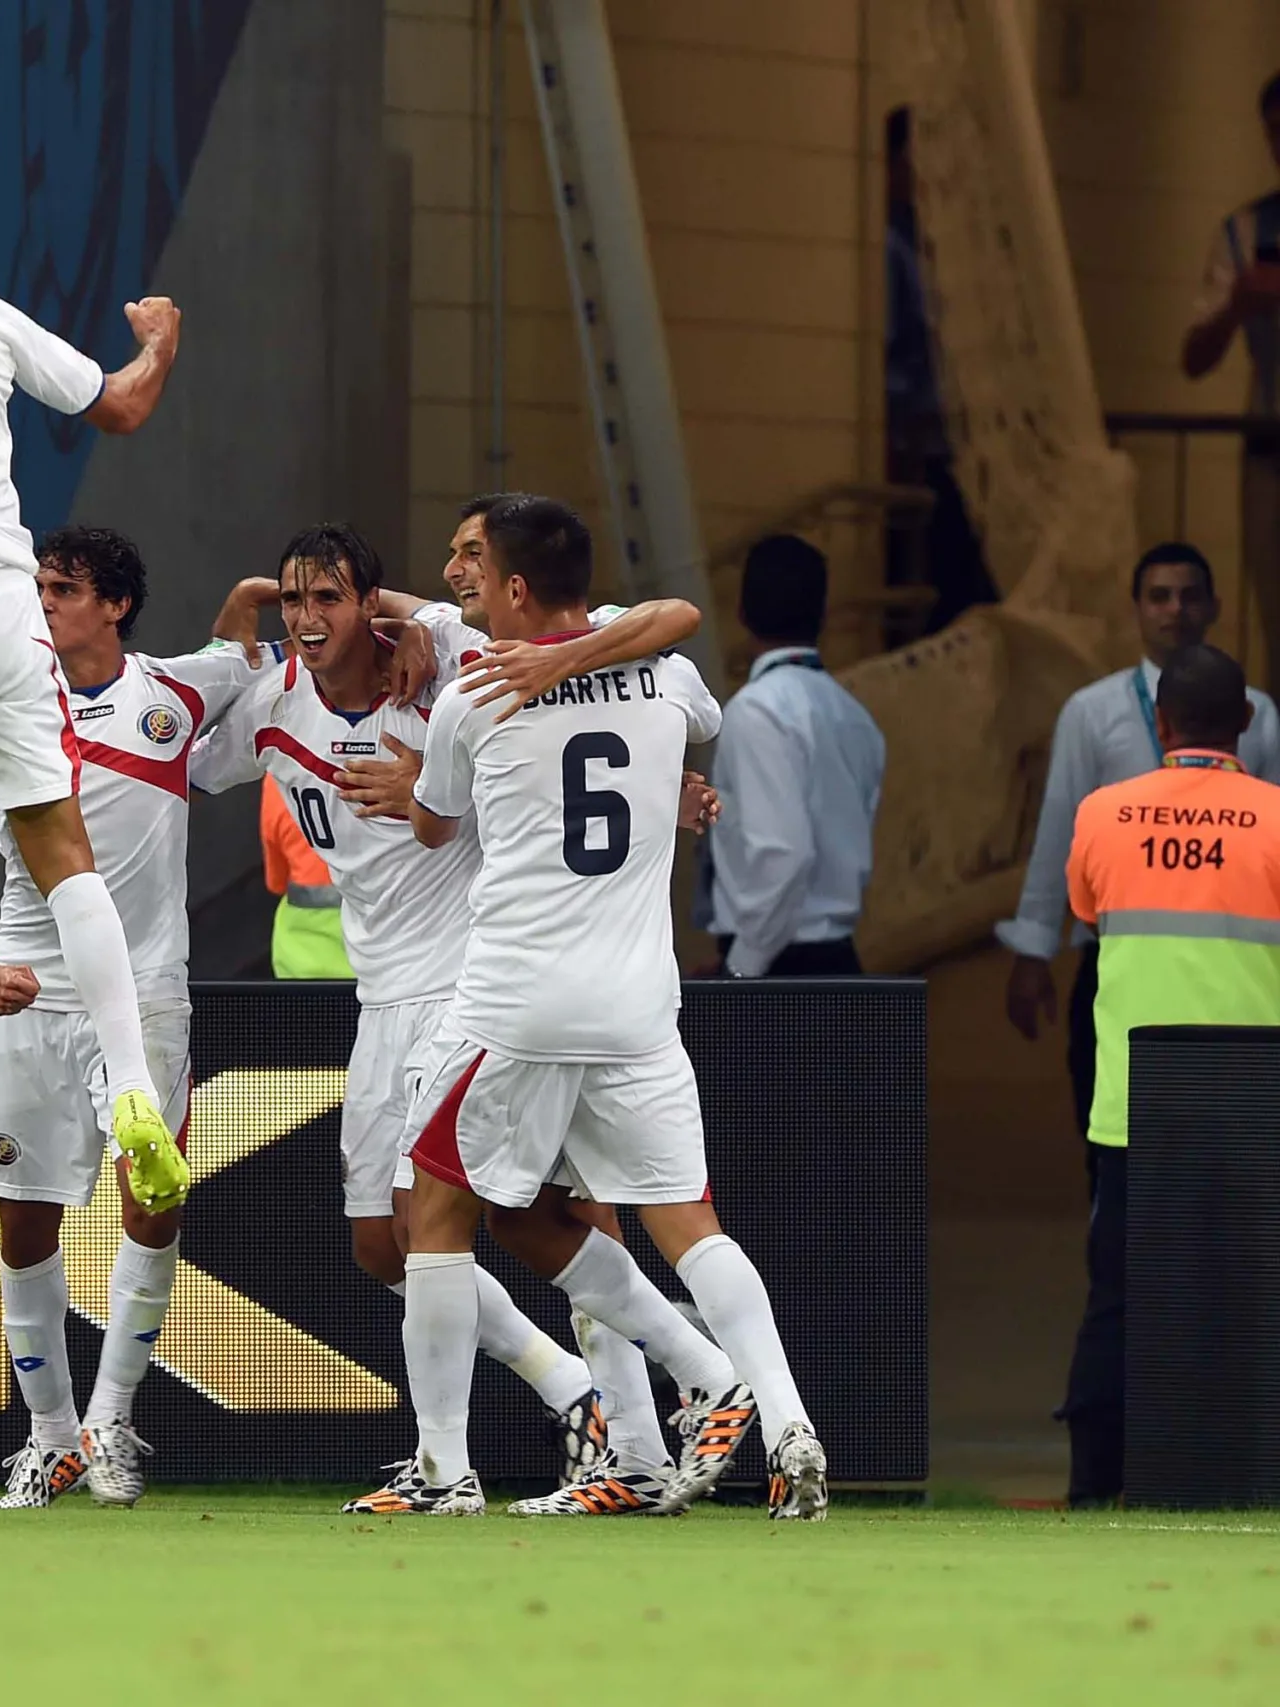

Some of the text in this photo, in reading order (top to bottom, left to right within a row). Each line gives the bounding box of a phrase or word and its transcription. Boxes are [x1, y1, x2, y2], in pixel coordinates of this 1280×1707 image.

[638, 667, 664, 700] O.
[291, 786, 335, 849] 10
[562, 731, 631, 877] 6
[1117, 805, 1257, 829] STEWARD
[1140, 835, 1225, 870] 1084
